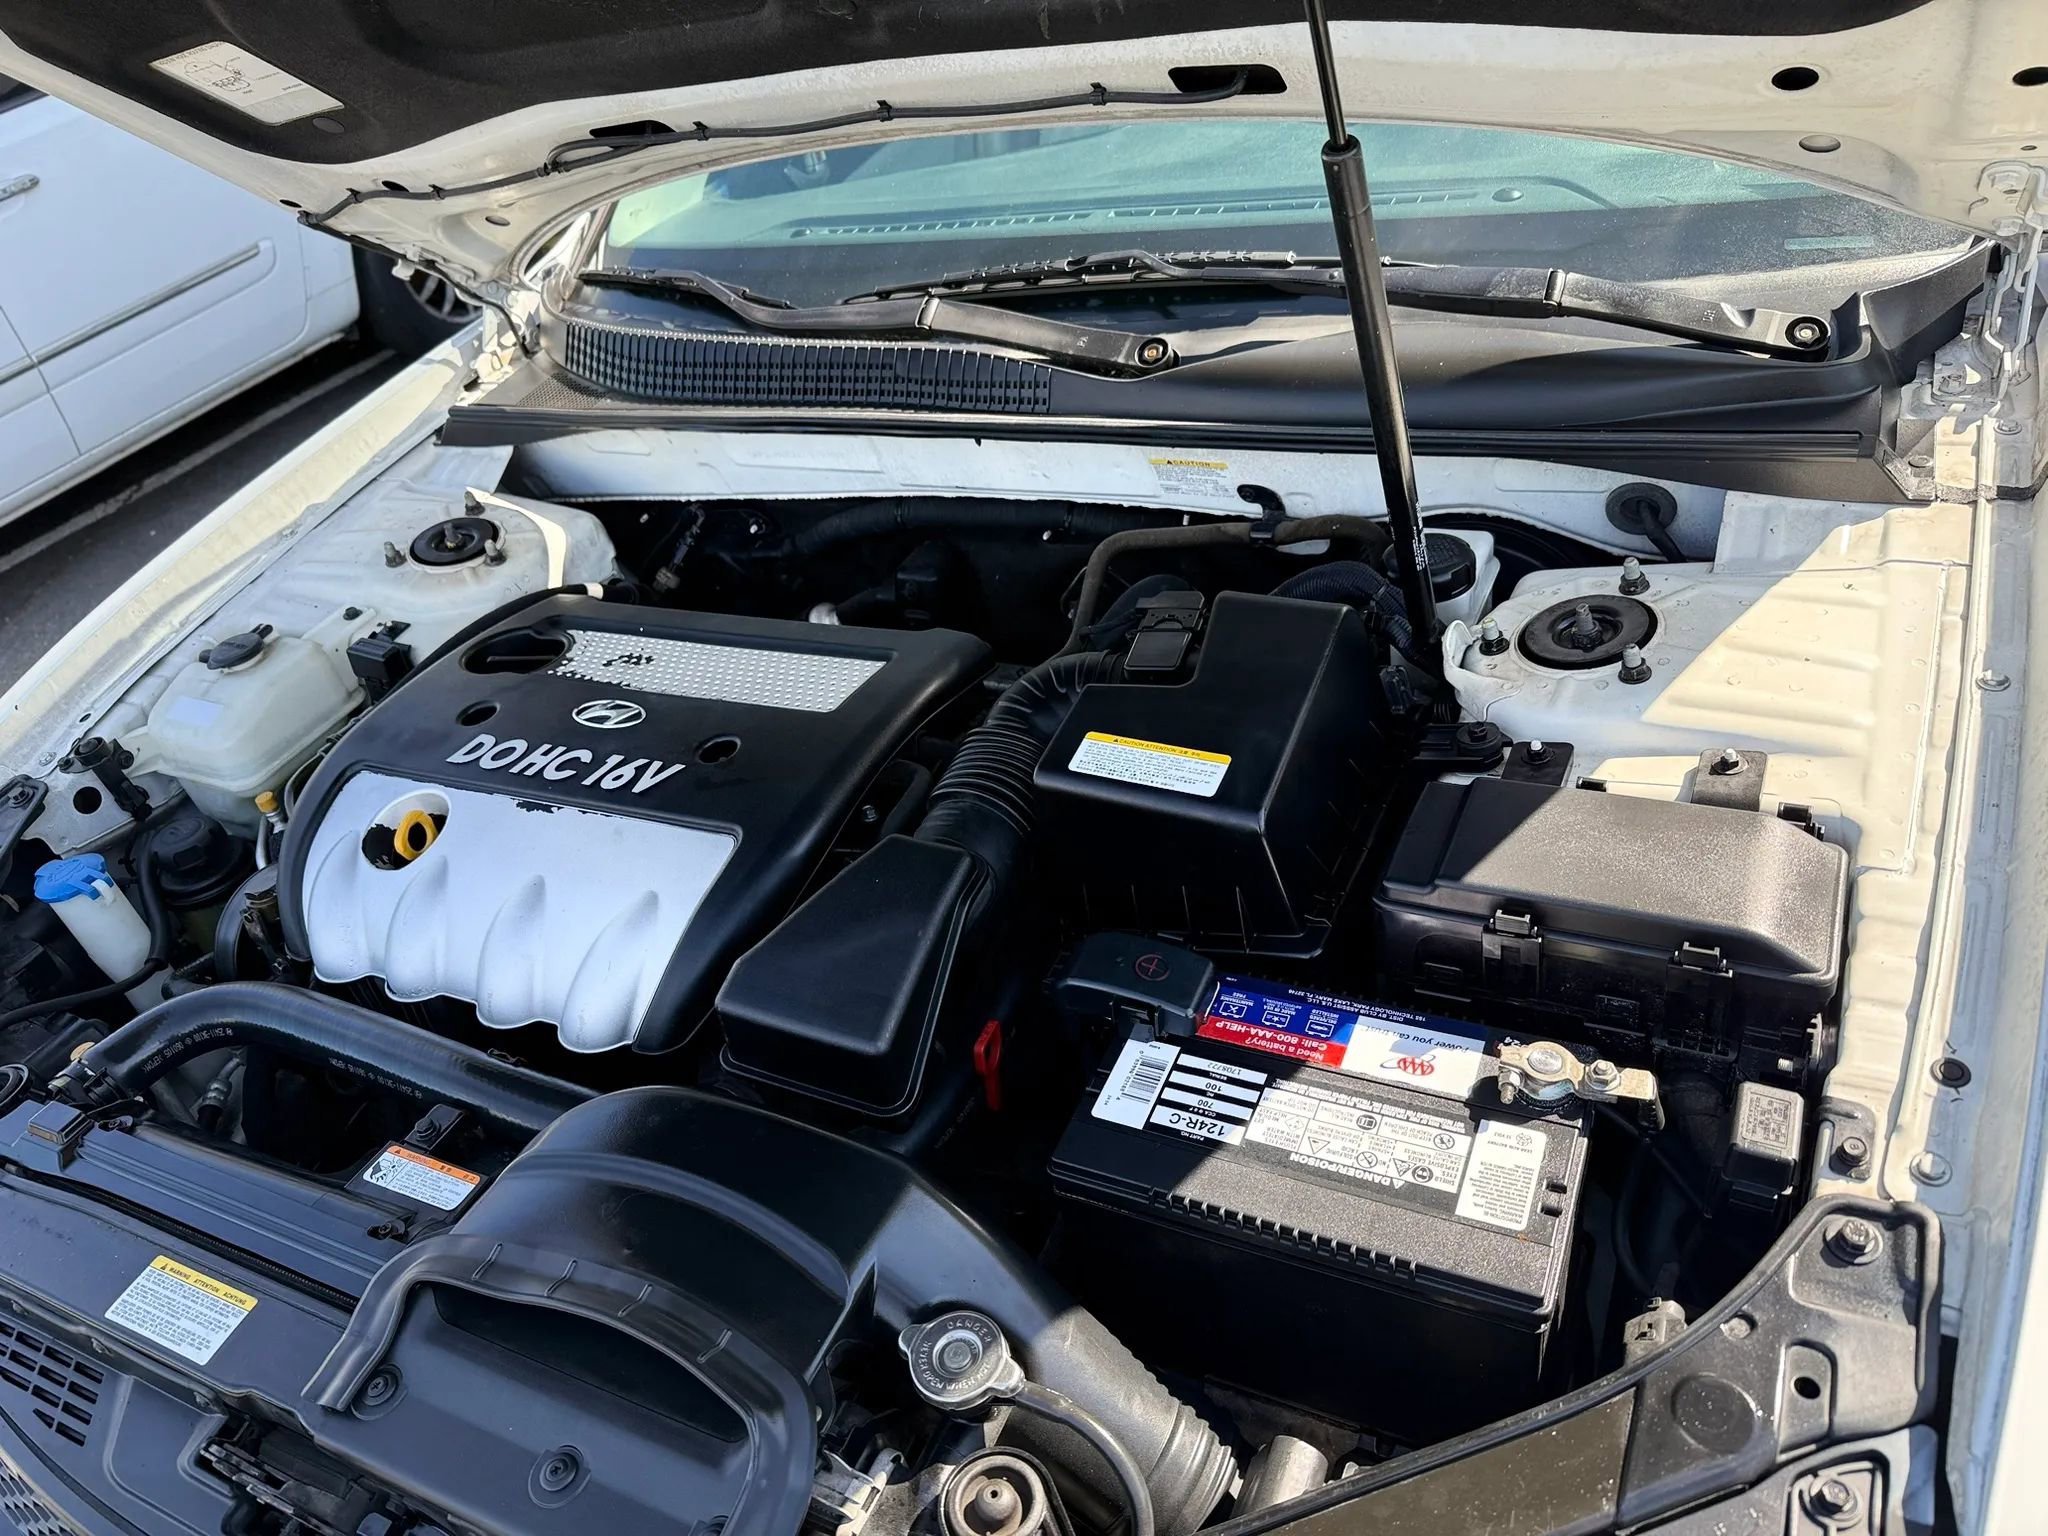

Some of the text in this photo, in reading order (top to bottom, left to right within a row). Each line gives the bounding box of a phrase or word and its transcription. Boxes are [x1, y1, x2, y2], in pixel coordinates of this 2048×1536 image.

[1173, 459, 1210, 467] CAUTION
[1144, 743, 1176, 752] ATTENTION
[445, 733, 686, 794] DOHC 16V
[1220, 995, 1253, 1006] MAINTENANCE
[1332, 997, 1350, 1005] LAKE
[1311, 1008, 1339, 1019] INSTALLED
[1360, 1008, 1376, 1016] CLUB
[1371, 1005, 1414, 1018] TECHNOLOGY
[1308, 1014, 1337, 1024] DELIVERED
[1215, 1018, 1327, 1050] Call: 800-AAA-HELP
[1391, 1029, 1409, 1041] can
[1410, 1033, 1433, 1046] you
[1244, 1034, 1286, 1051] battery?
[1436, 1040, 1469, 1054] Power
[1296, 1047, 1324, 1060] Need
[1206, 1061, 1242, 1075] 1708722
[1397, 1055, 1435, 1076] AAA
[1207, 1072, 1227, 1080] SERIAL
[1203, 1081, 1223, 1091] 100
[1196, 1098, 1214, 1108] 700
[1166, 1112, 1227, 1137] 124R-C
[1285, 1130, 1300, 1139] WITH
[1325, 1147, 1353, 1160] SULFURIC
[1289, 1151, 1390, 1186] DANGER/POISON
[1406, 1154, 1459, 1173] EXPLOSIVE GASES
[1433, 1175, 1455, 1185] SHIELD
[168, 1266, 247, 1305] WARNING ATTENTION ACHTUNG
[947, 1319, 993, 1343] DANGER
[919, 1341, 933, 1370] NEVER
[923, 1370, 945, 1389] OPEN
[946, 1376, 976, 1390] WHEN
